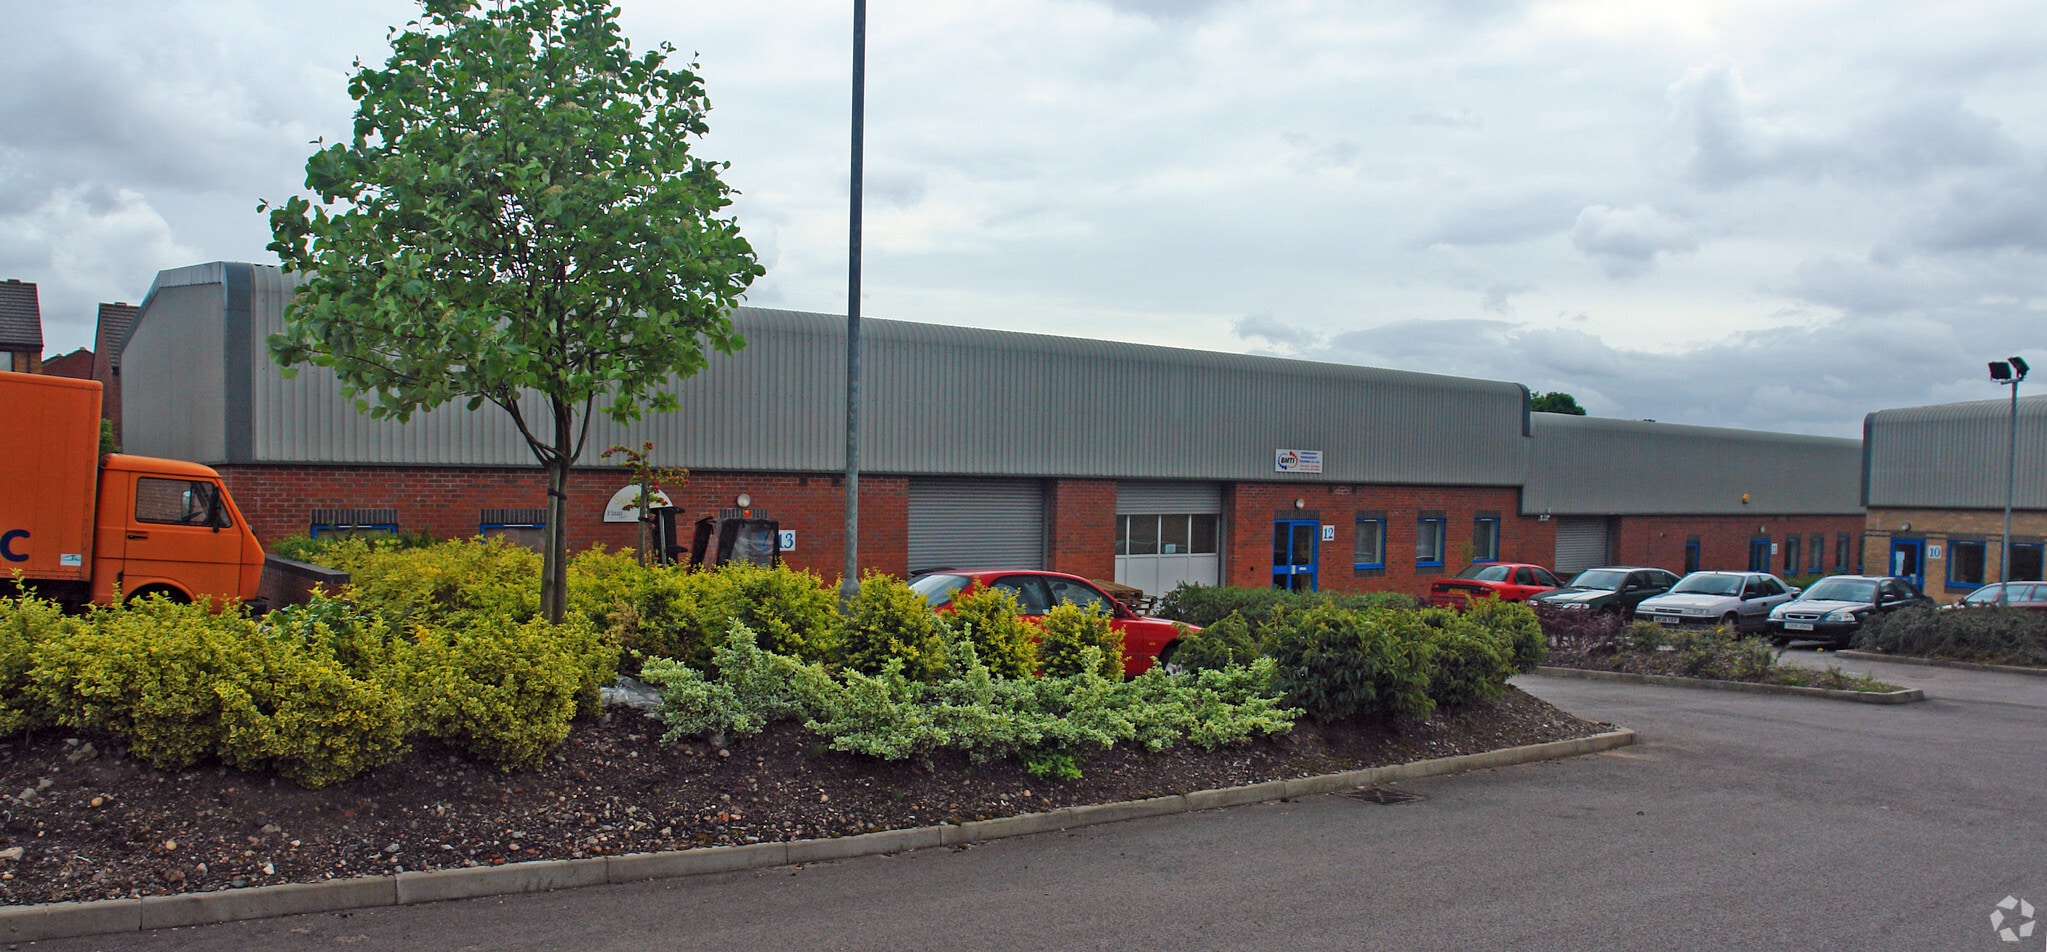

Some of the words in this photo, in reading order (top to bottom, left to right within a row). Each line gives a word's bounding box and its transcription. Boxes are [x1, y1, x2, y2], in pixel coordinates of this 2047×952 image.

[1323, 527, 1334, 539] 12
[0, 529, 30, 562] C
[778, 533, 793, 548] 13
[1930, 546, 1940, 557] 10
